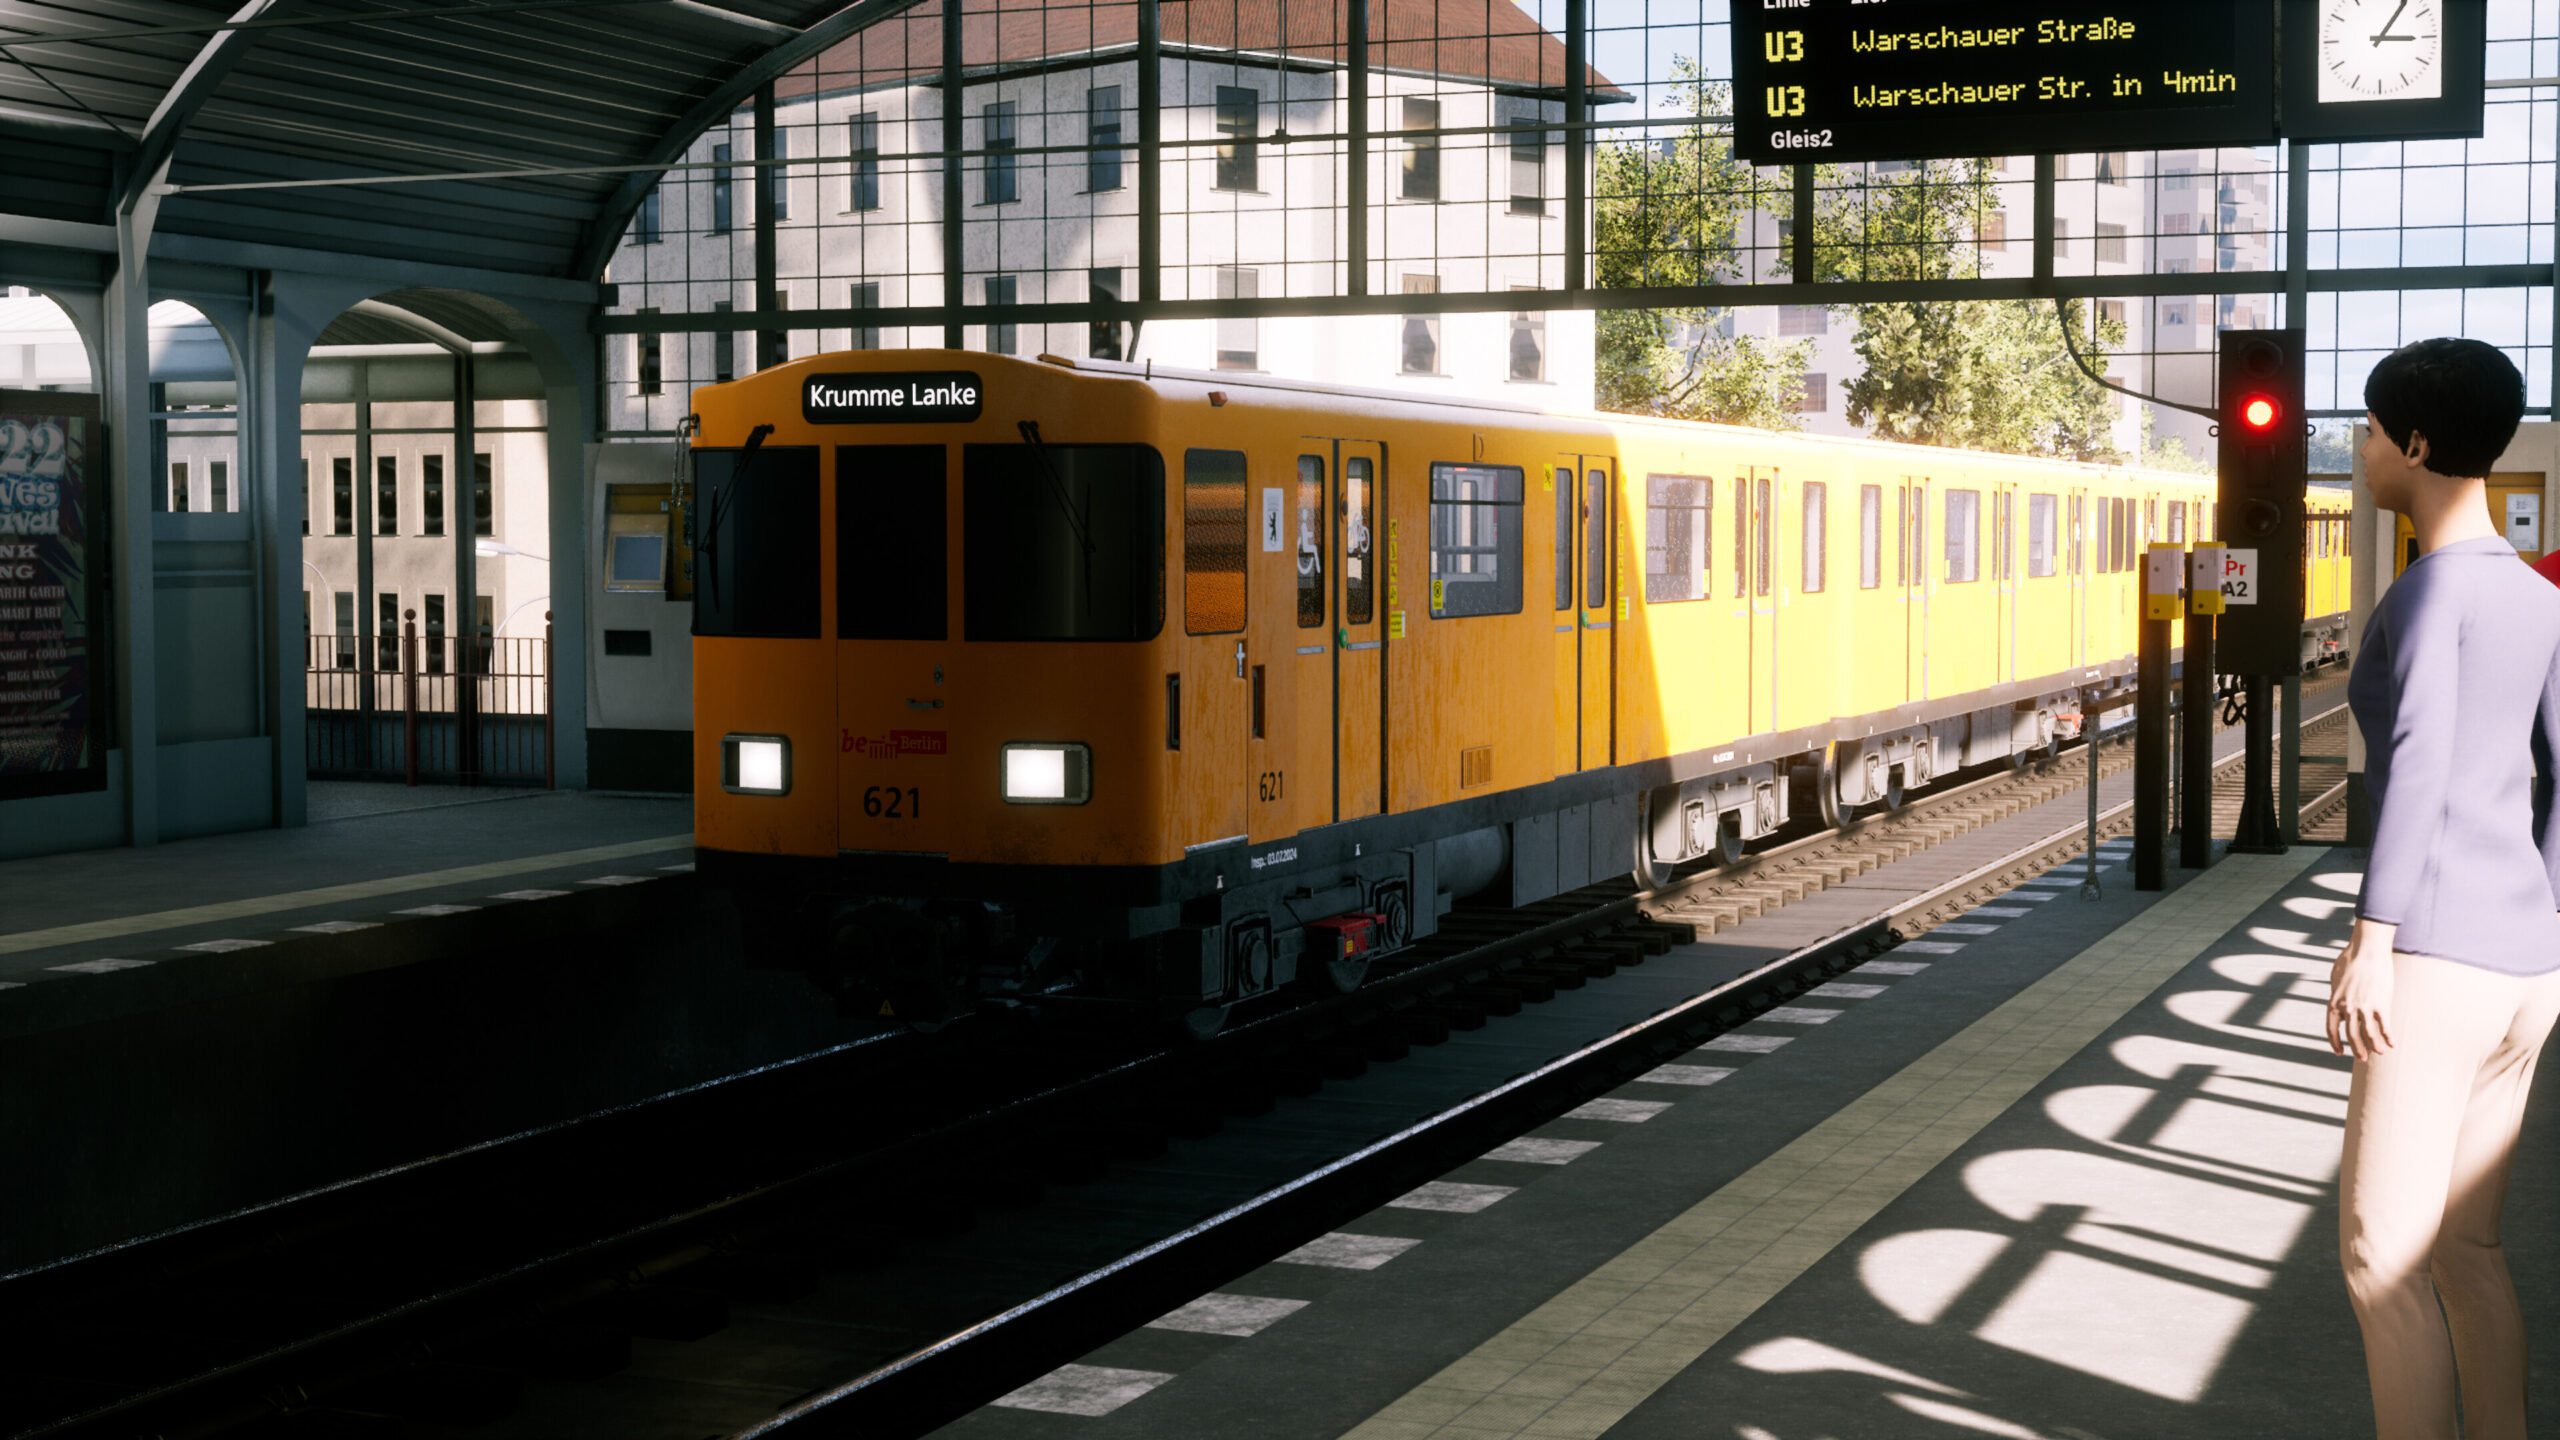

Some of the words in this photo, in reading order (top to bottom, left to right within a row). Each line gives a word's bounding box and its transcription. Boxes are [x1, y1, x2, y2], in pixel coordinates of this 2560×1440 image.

[1765, 30, 1804, 62] U3
[1852, 26, 2025, 52] Warschauer
[2038, 17, 2136, 43] Straße
[1766, 85, 1806, 117] U3
[1854, 82, 2026, 107] Warschauer
[2039, 77, 2091, 99] Str.
[2113, 73, 2142, 96] in
[2164, 69, 2236, 93] 4min
[811, 384, 905, 407] Krumme
[912, 381, 977, 406] Lanke
[2225, 560, 2247, 576] Pr
[2224, 581, 2248, 597] A2
[900, 736, 942, 751] Berlin
[1259, 770, 1283, 802] 621
[863, 786, 919, 818] 621
